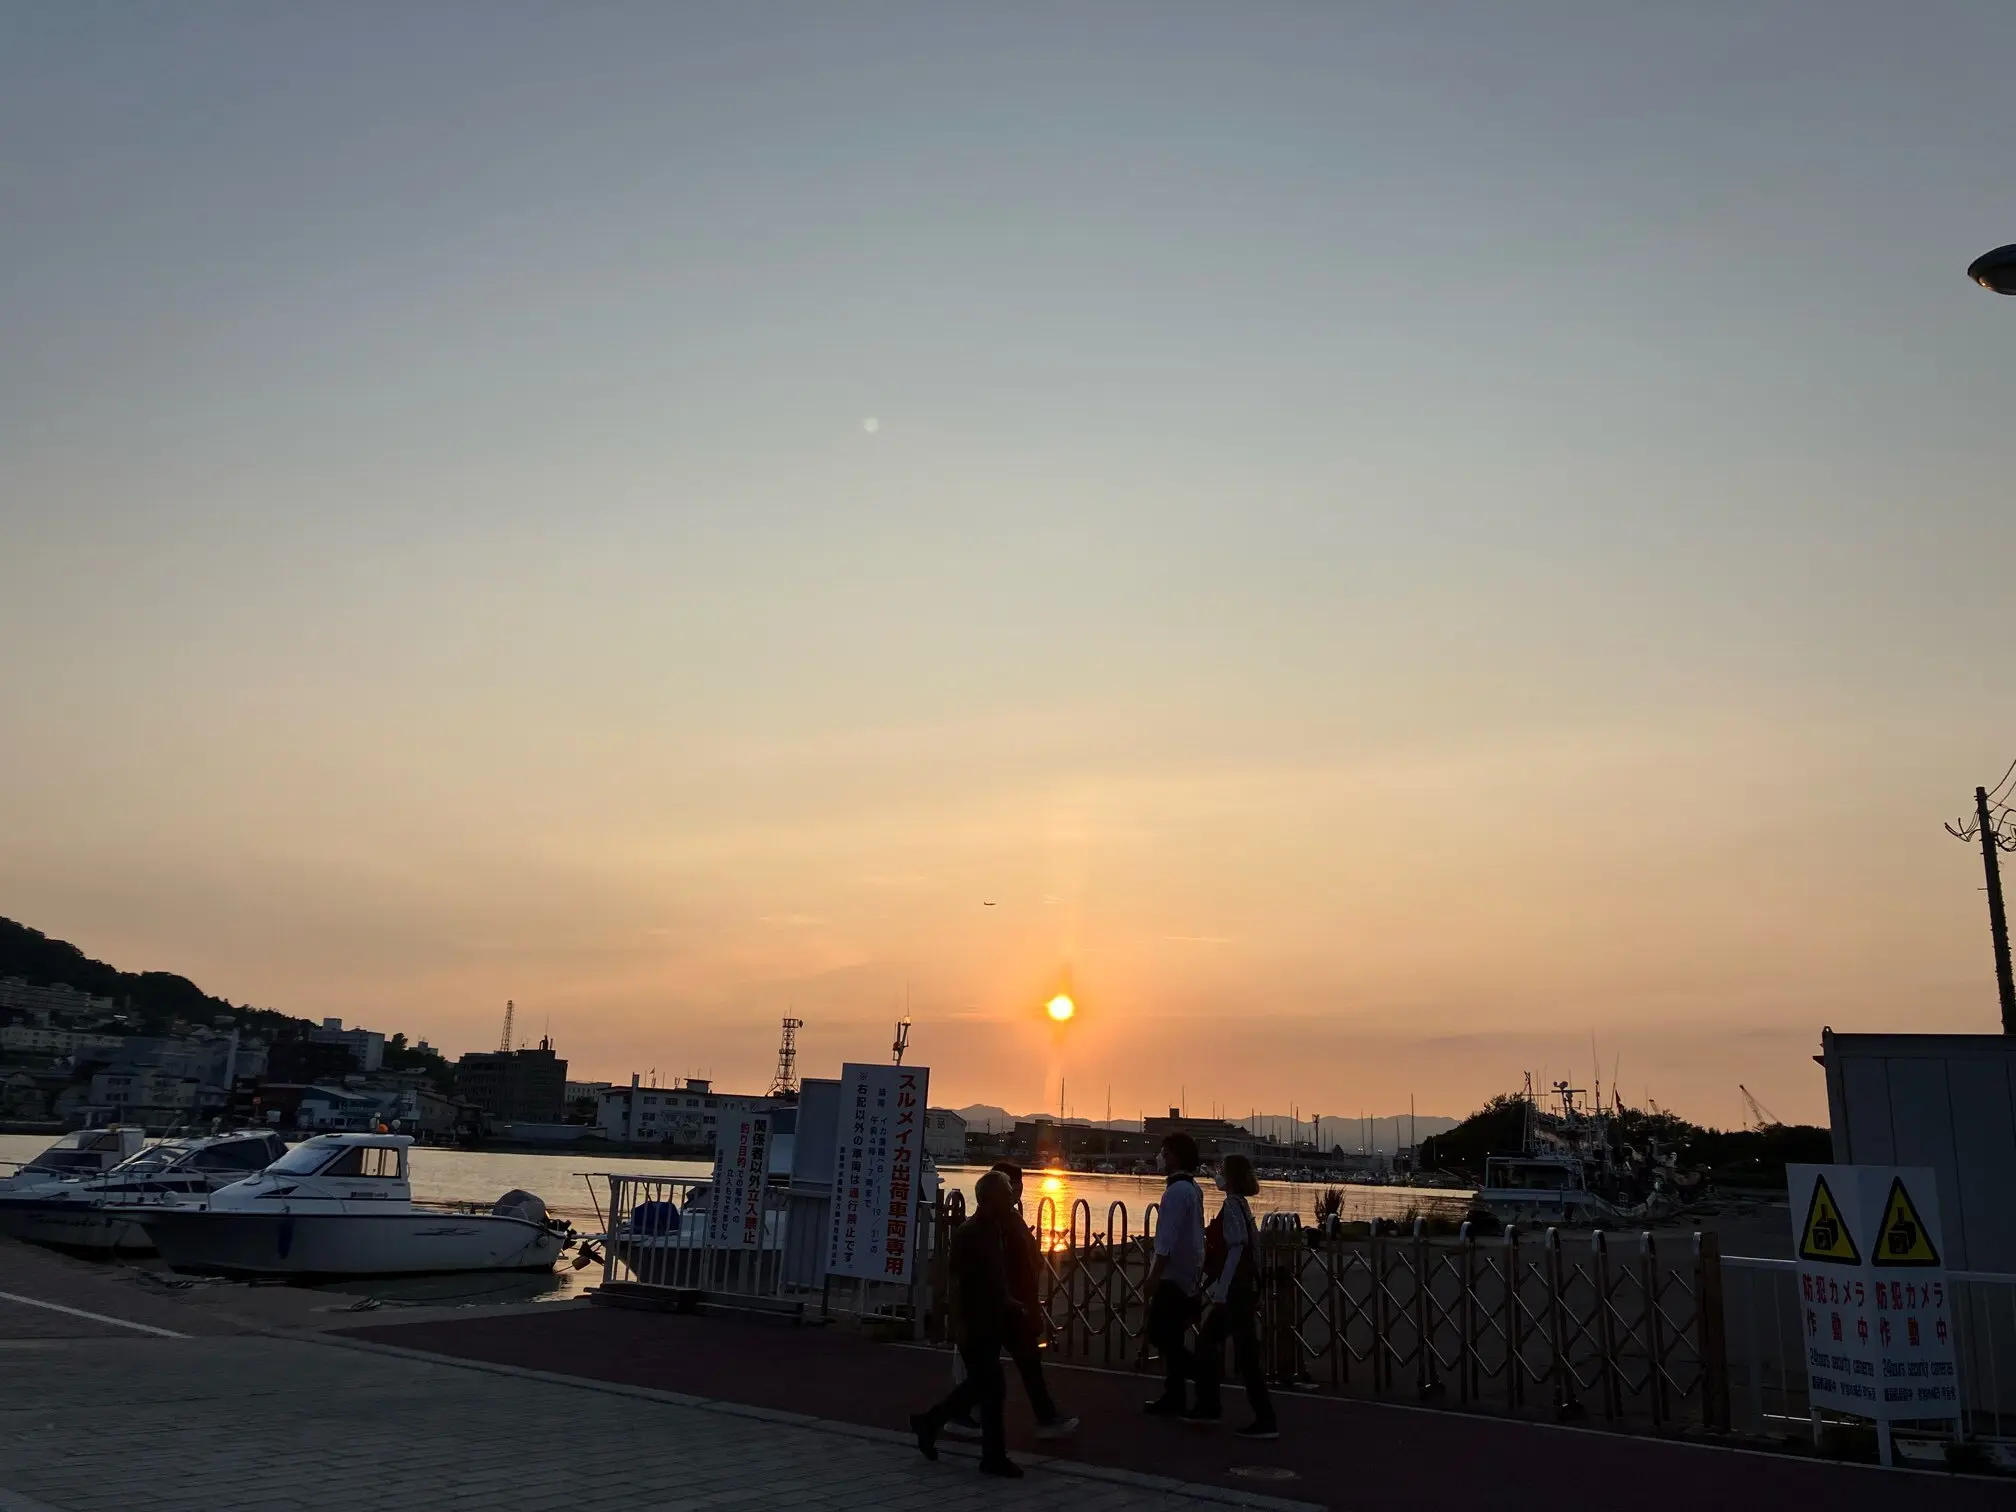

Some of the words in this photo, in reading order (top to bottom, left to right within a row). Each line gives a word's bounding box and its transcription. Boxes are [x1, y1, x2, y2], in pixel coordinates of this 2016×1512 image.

[743, 1119, 767, 1245] 関係者以外立入禁止
[884, 1074, 917, 1276] スルメイカ出荷車両専用
[1802, 1272, 1865, 1307] 防犯カメラ
[1875, 1281, 1944, 1311] 防犯カメラ
